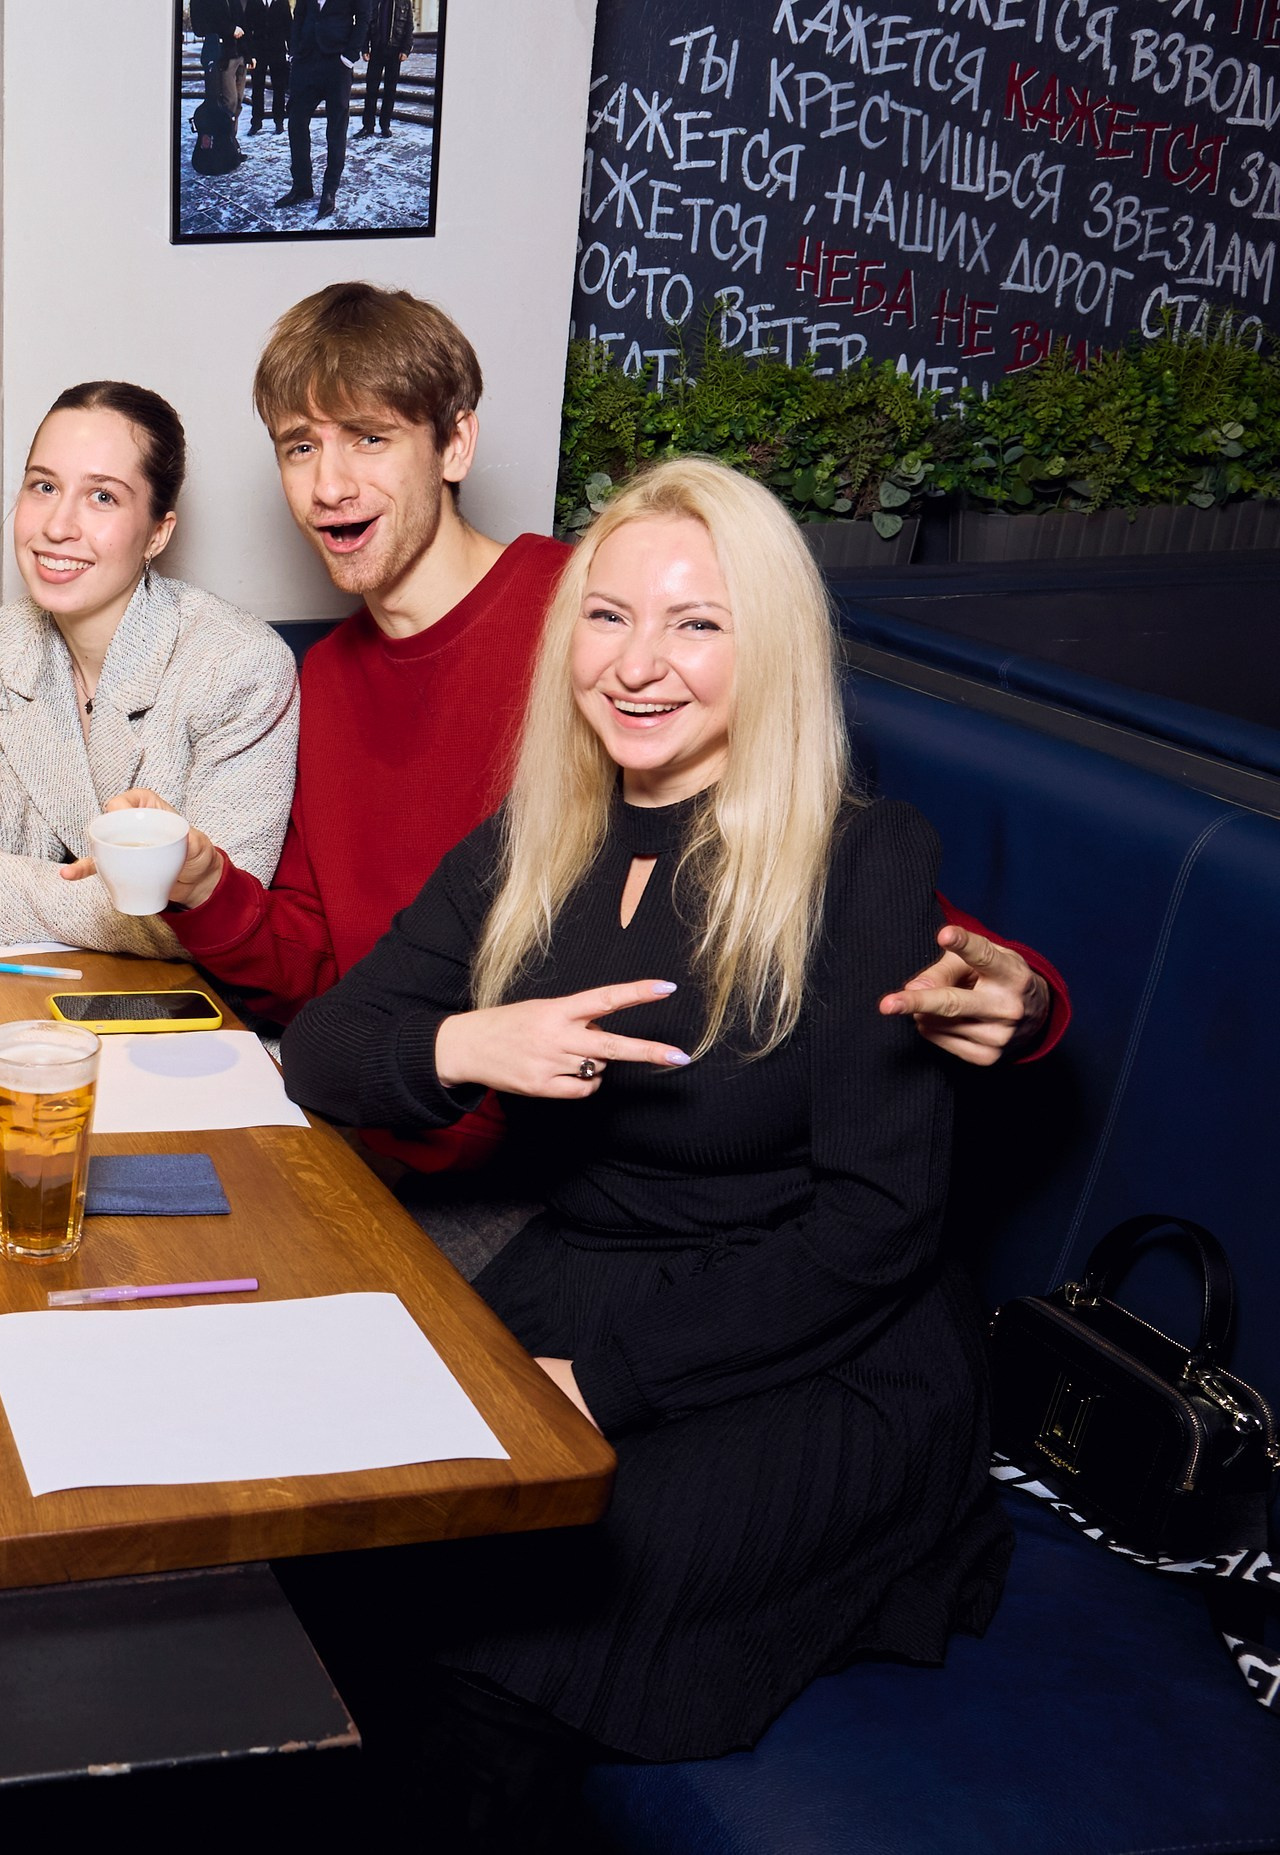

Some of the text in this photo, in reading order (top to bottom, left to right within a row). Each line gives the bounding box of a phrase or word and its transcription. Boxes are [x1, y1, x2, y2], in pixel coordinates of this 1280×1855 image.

[670, 25, 1277, 304] ТЫ КРЕСТИШЬСЯ ЗВЕЗДАМ
[1004, 60, 1229, 195] КАЖЕТСЯ
[577, 237, 693, 327] ОСТО
[785, 235, 917, 329] НЕБА
[931, 289, 999, 359] НЕ
[825, 166, 997, 275] НАШИХ
[1000, 238, 1135, 327] ДОРОГ
